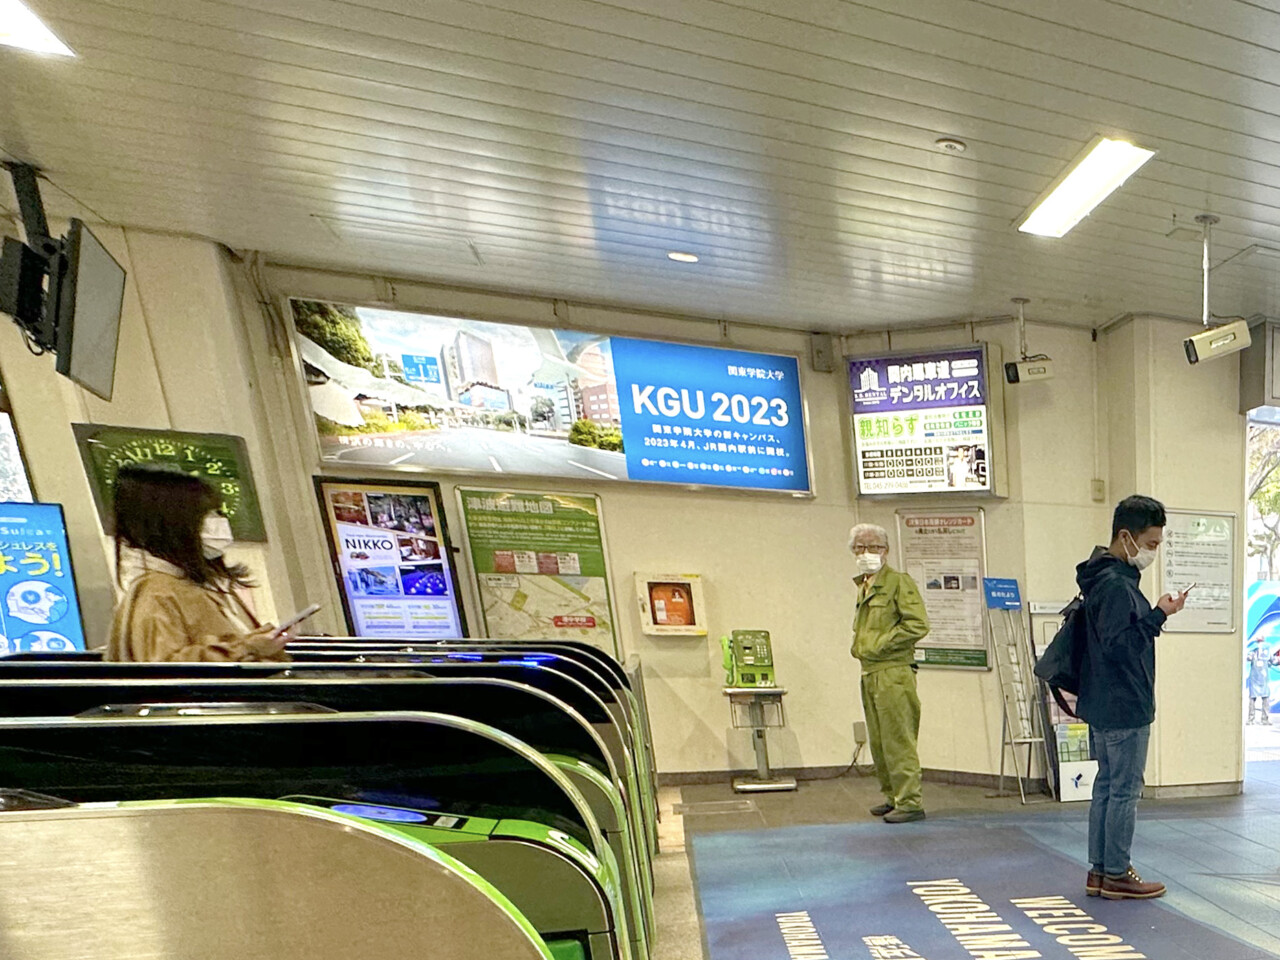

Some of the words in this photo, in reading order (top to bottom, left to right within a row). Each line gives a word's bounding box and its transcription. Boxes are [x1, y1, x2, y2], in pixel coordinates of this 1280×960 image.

[727, 365, 785, 381] 関東学院大学
[889, 380, 981, 405] デンタルオフィス
[631, 383, 706, 420] KGU
[711, 391, 790, 428] 2023
[859, 415, 919, 438] 親知らず
[153, 442, 176, 456] 12
[206, 462, 220, 475] 2
[222, 482, 235, 495] 3
[345, 538, 393, 551] NIKKO
